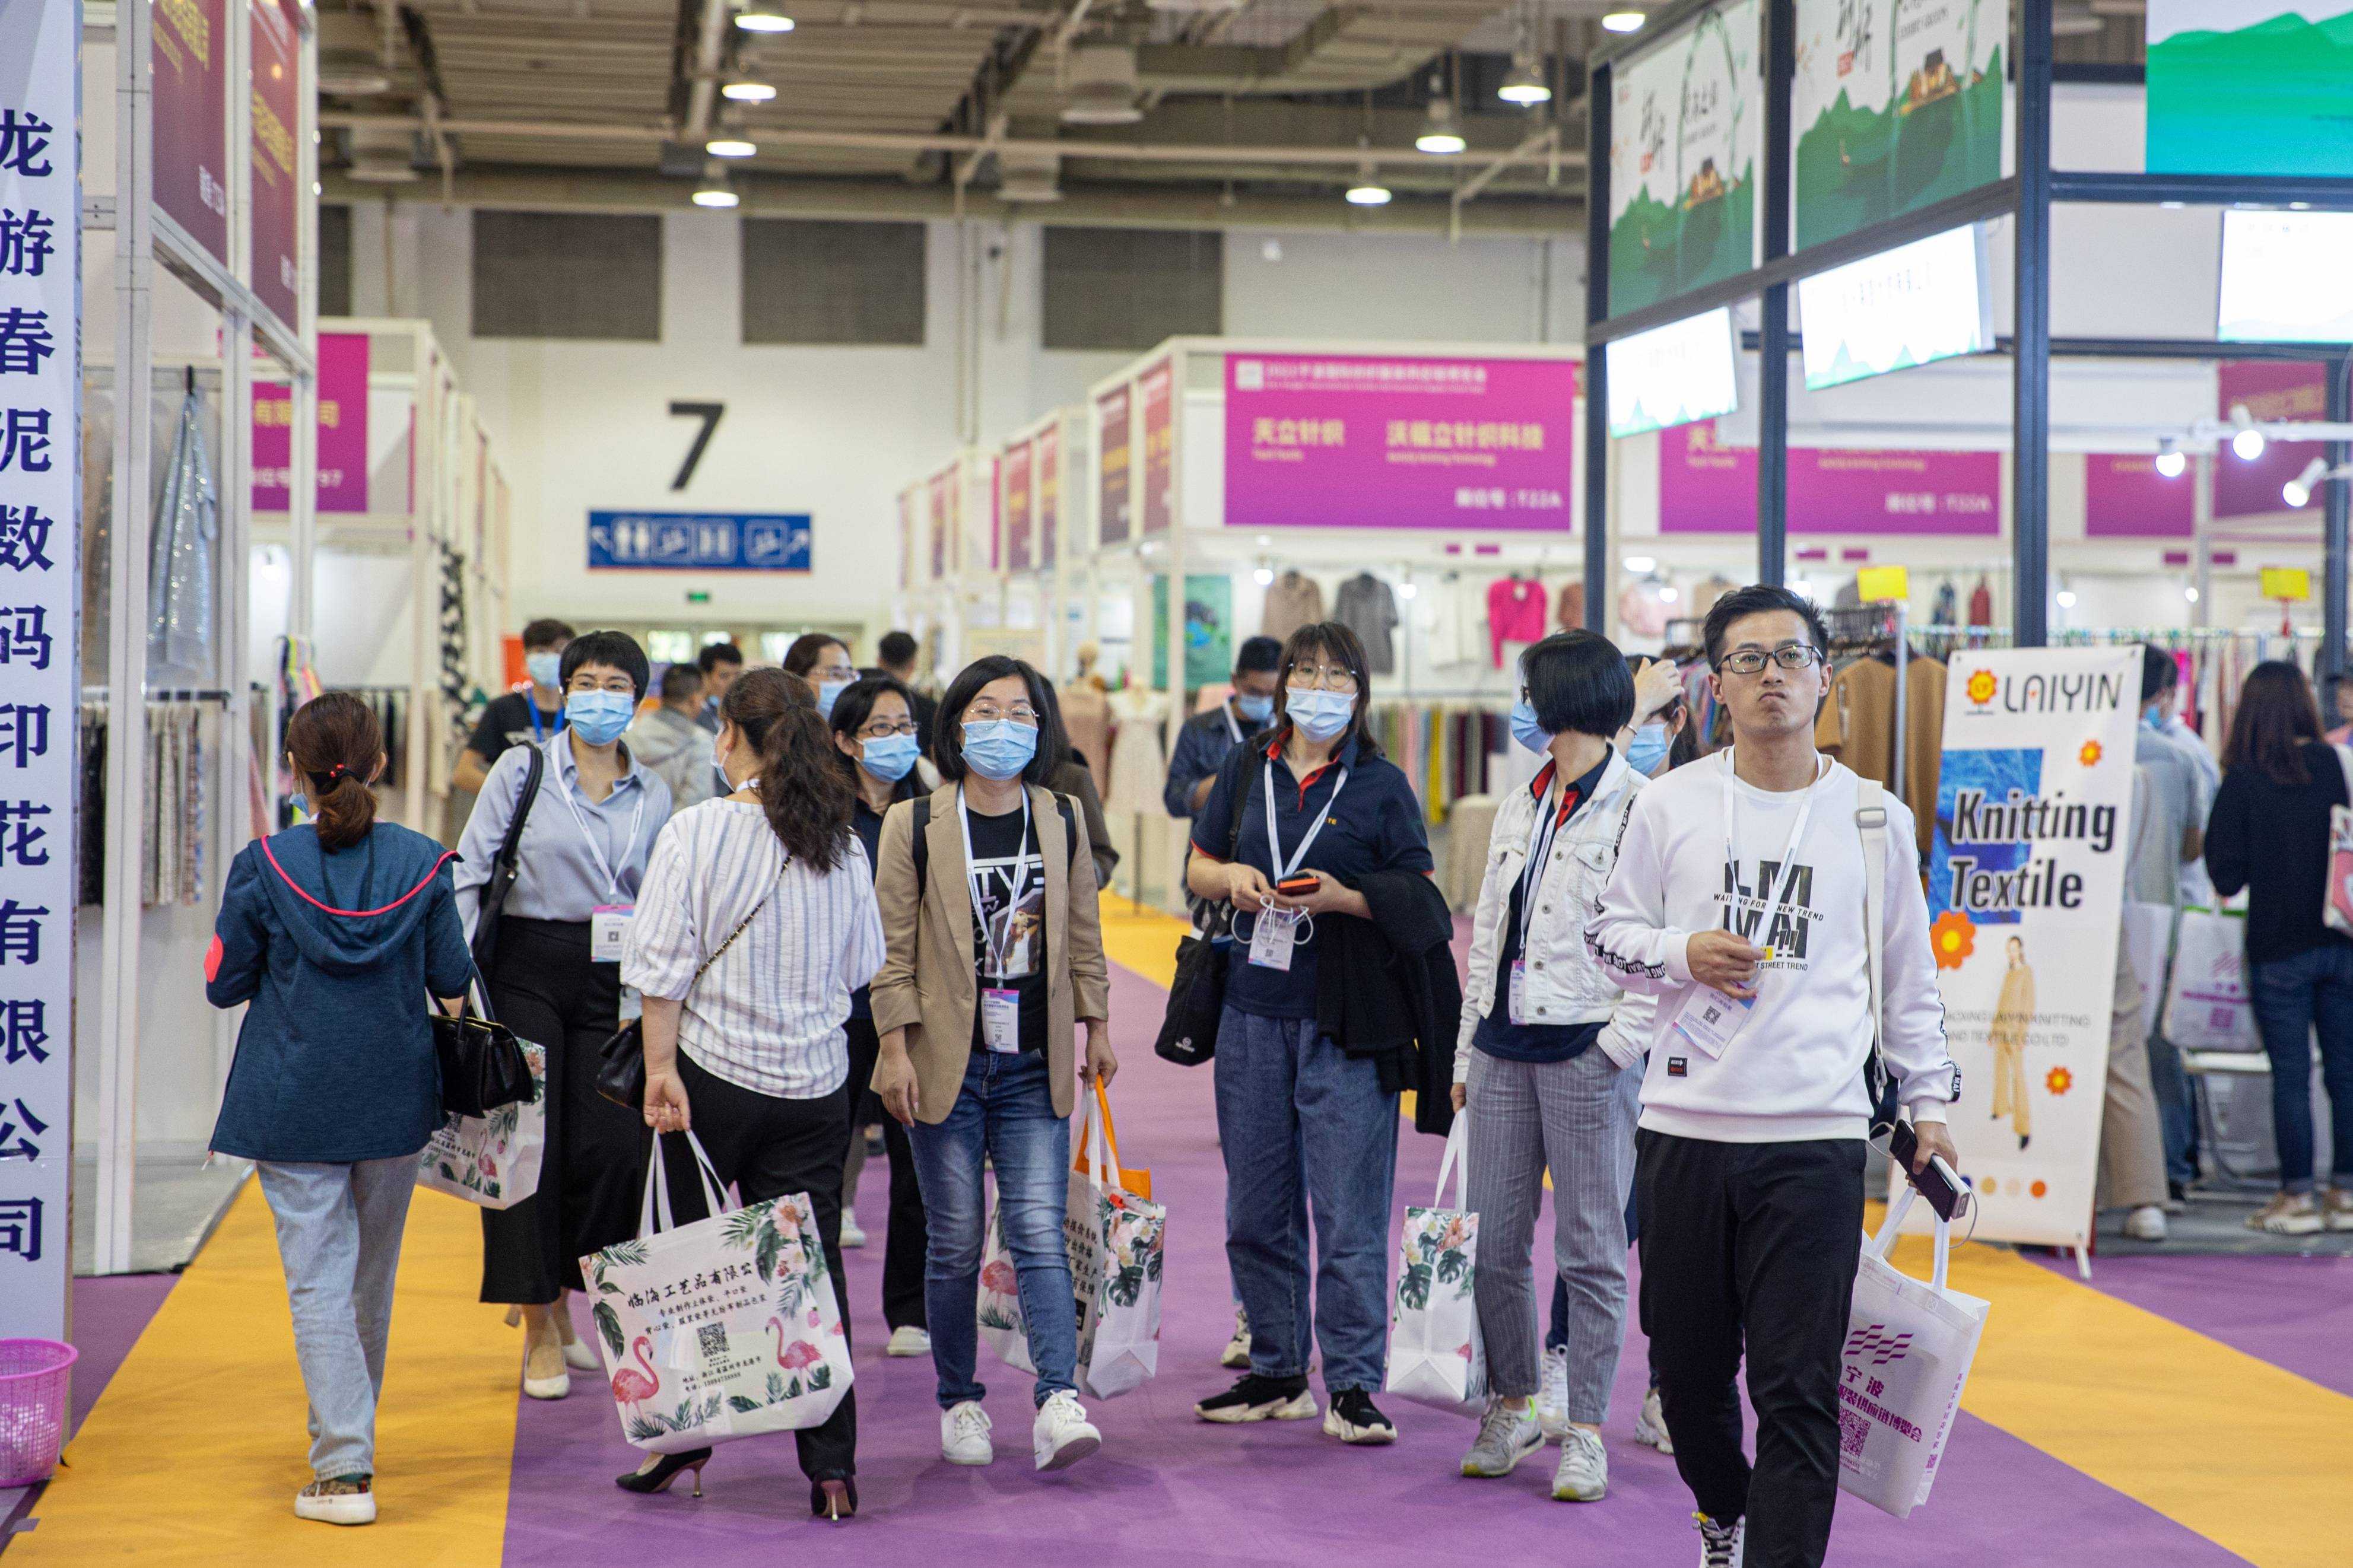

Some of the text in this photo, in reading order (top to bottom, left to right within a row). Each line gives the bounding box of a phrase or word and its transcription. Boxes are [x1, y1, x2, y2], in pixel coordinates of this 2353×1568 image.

[669, 401, 725, 491] 7
[2003, 673, 2123, 714] LAIYIN
[1952, 790, 2117, 853] Knitting
[1951, 859, 2083, 909] Textile
[1714, 892, 1824, 921] WAITNG FOR NEW TREND
[1651, 964, 1665, 977] ONG
[1787, 962, 1808, 971] TREND
[1846, 1365, 1885, 1399] 宁波
